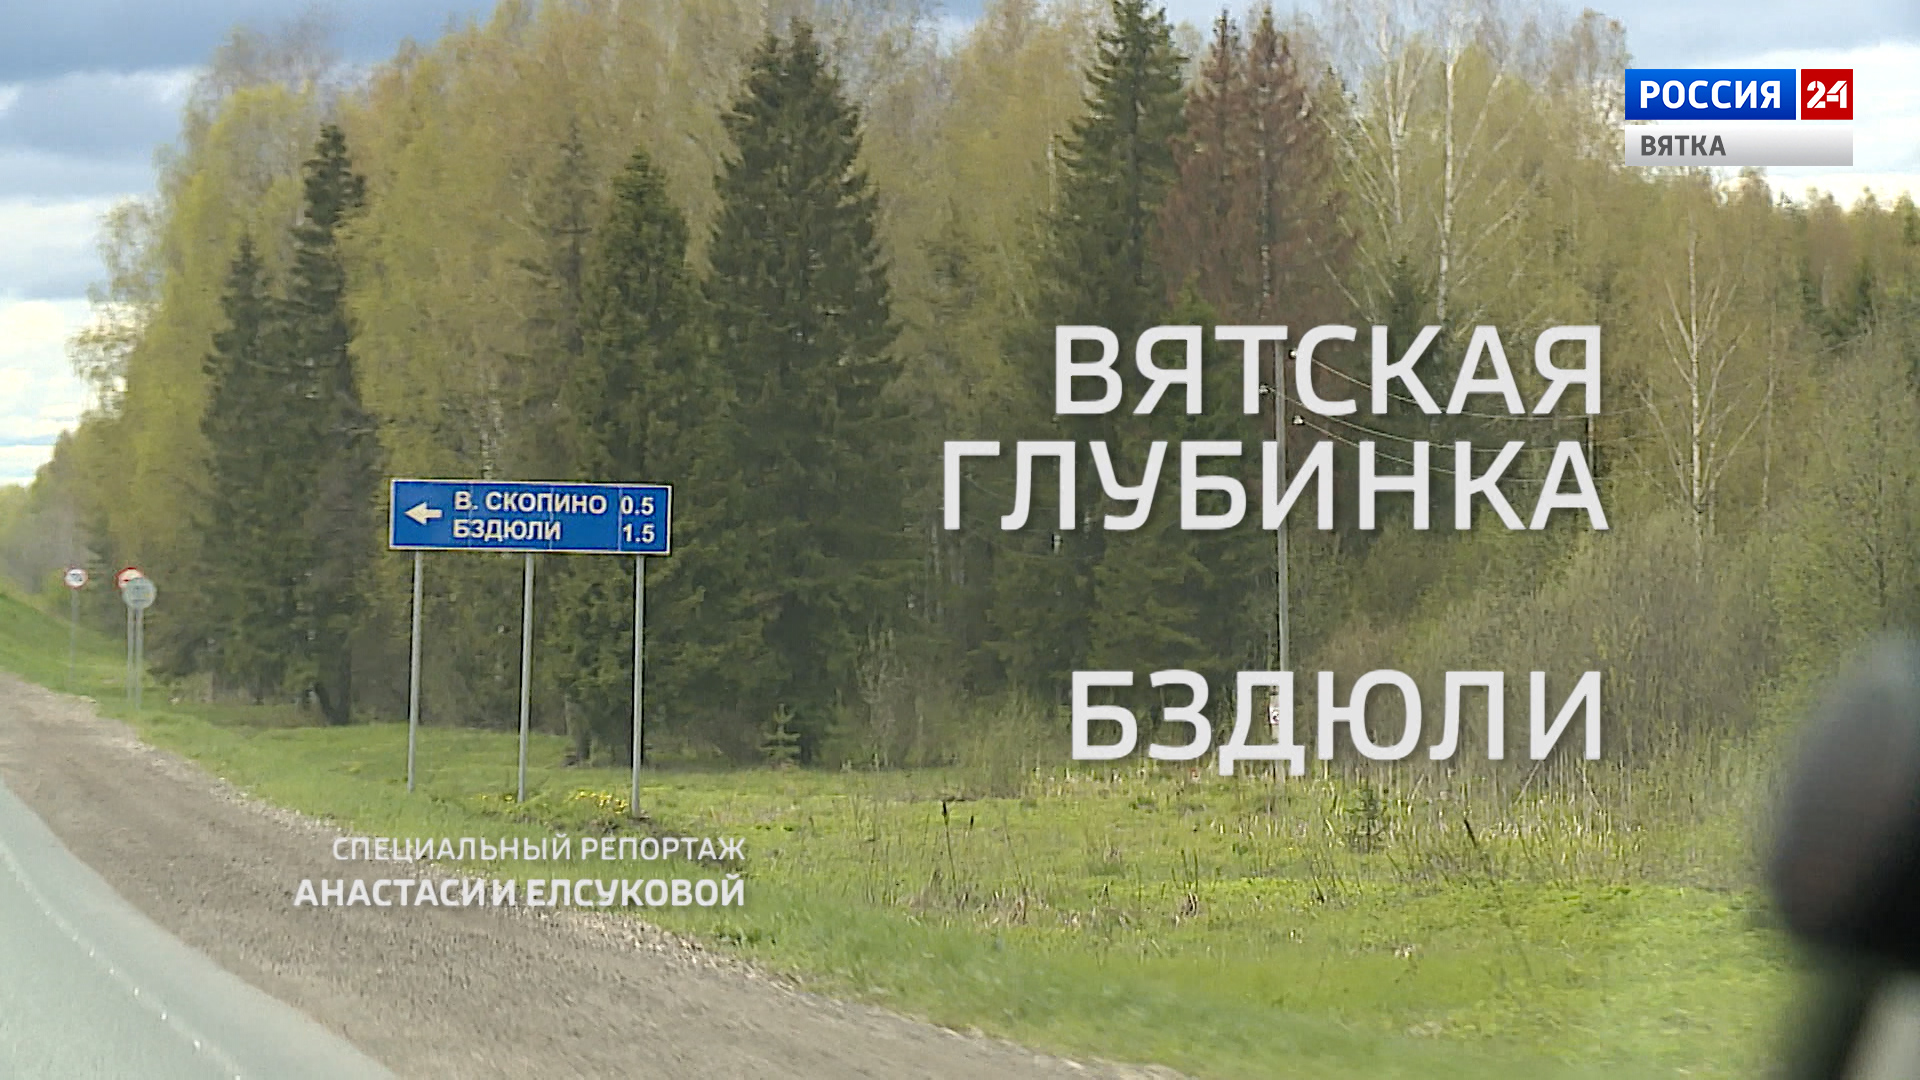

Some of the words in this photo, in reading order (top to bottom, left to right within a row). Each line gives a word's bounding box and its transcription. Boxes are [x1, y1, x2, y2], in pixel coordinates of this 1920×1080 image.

[454, 490, 478, 511] В.
[485, 491, 607, 515] СКОПИНО
[619, 496, 655, 516] 0.5
[453, 518, 562, 542] БЗДЮЛИ
[622, 523, 656, 544] 1.5
